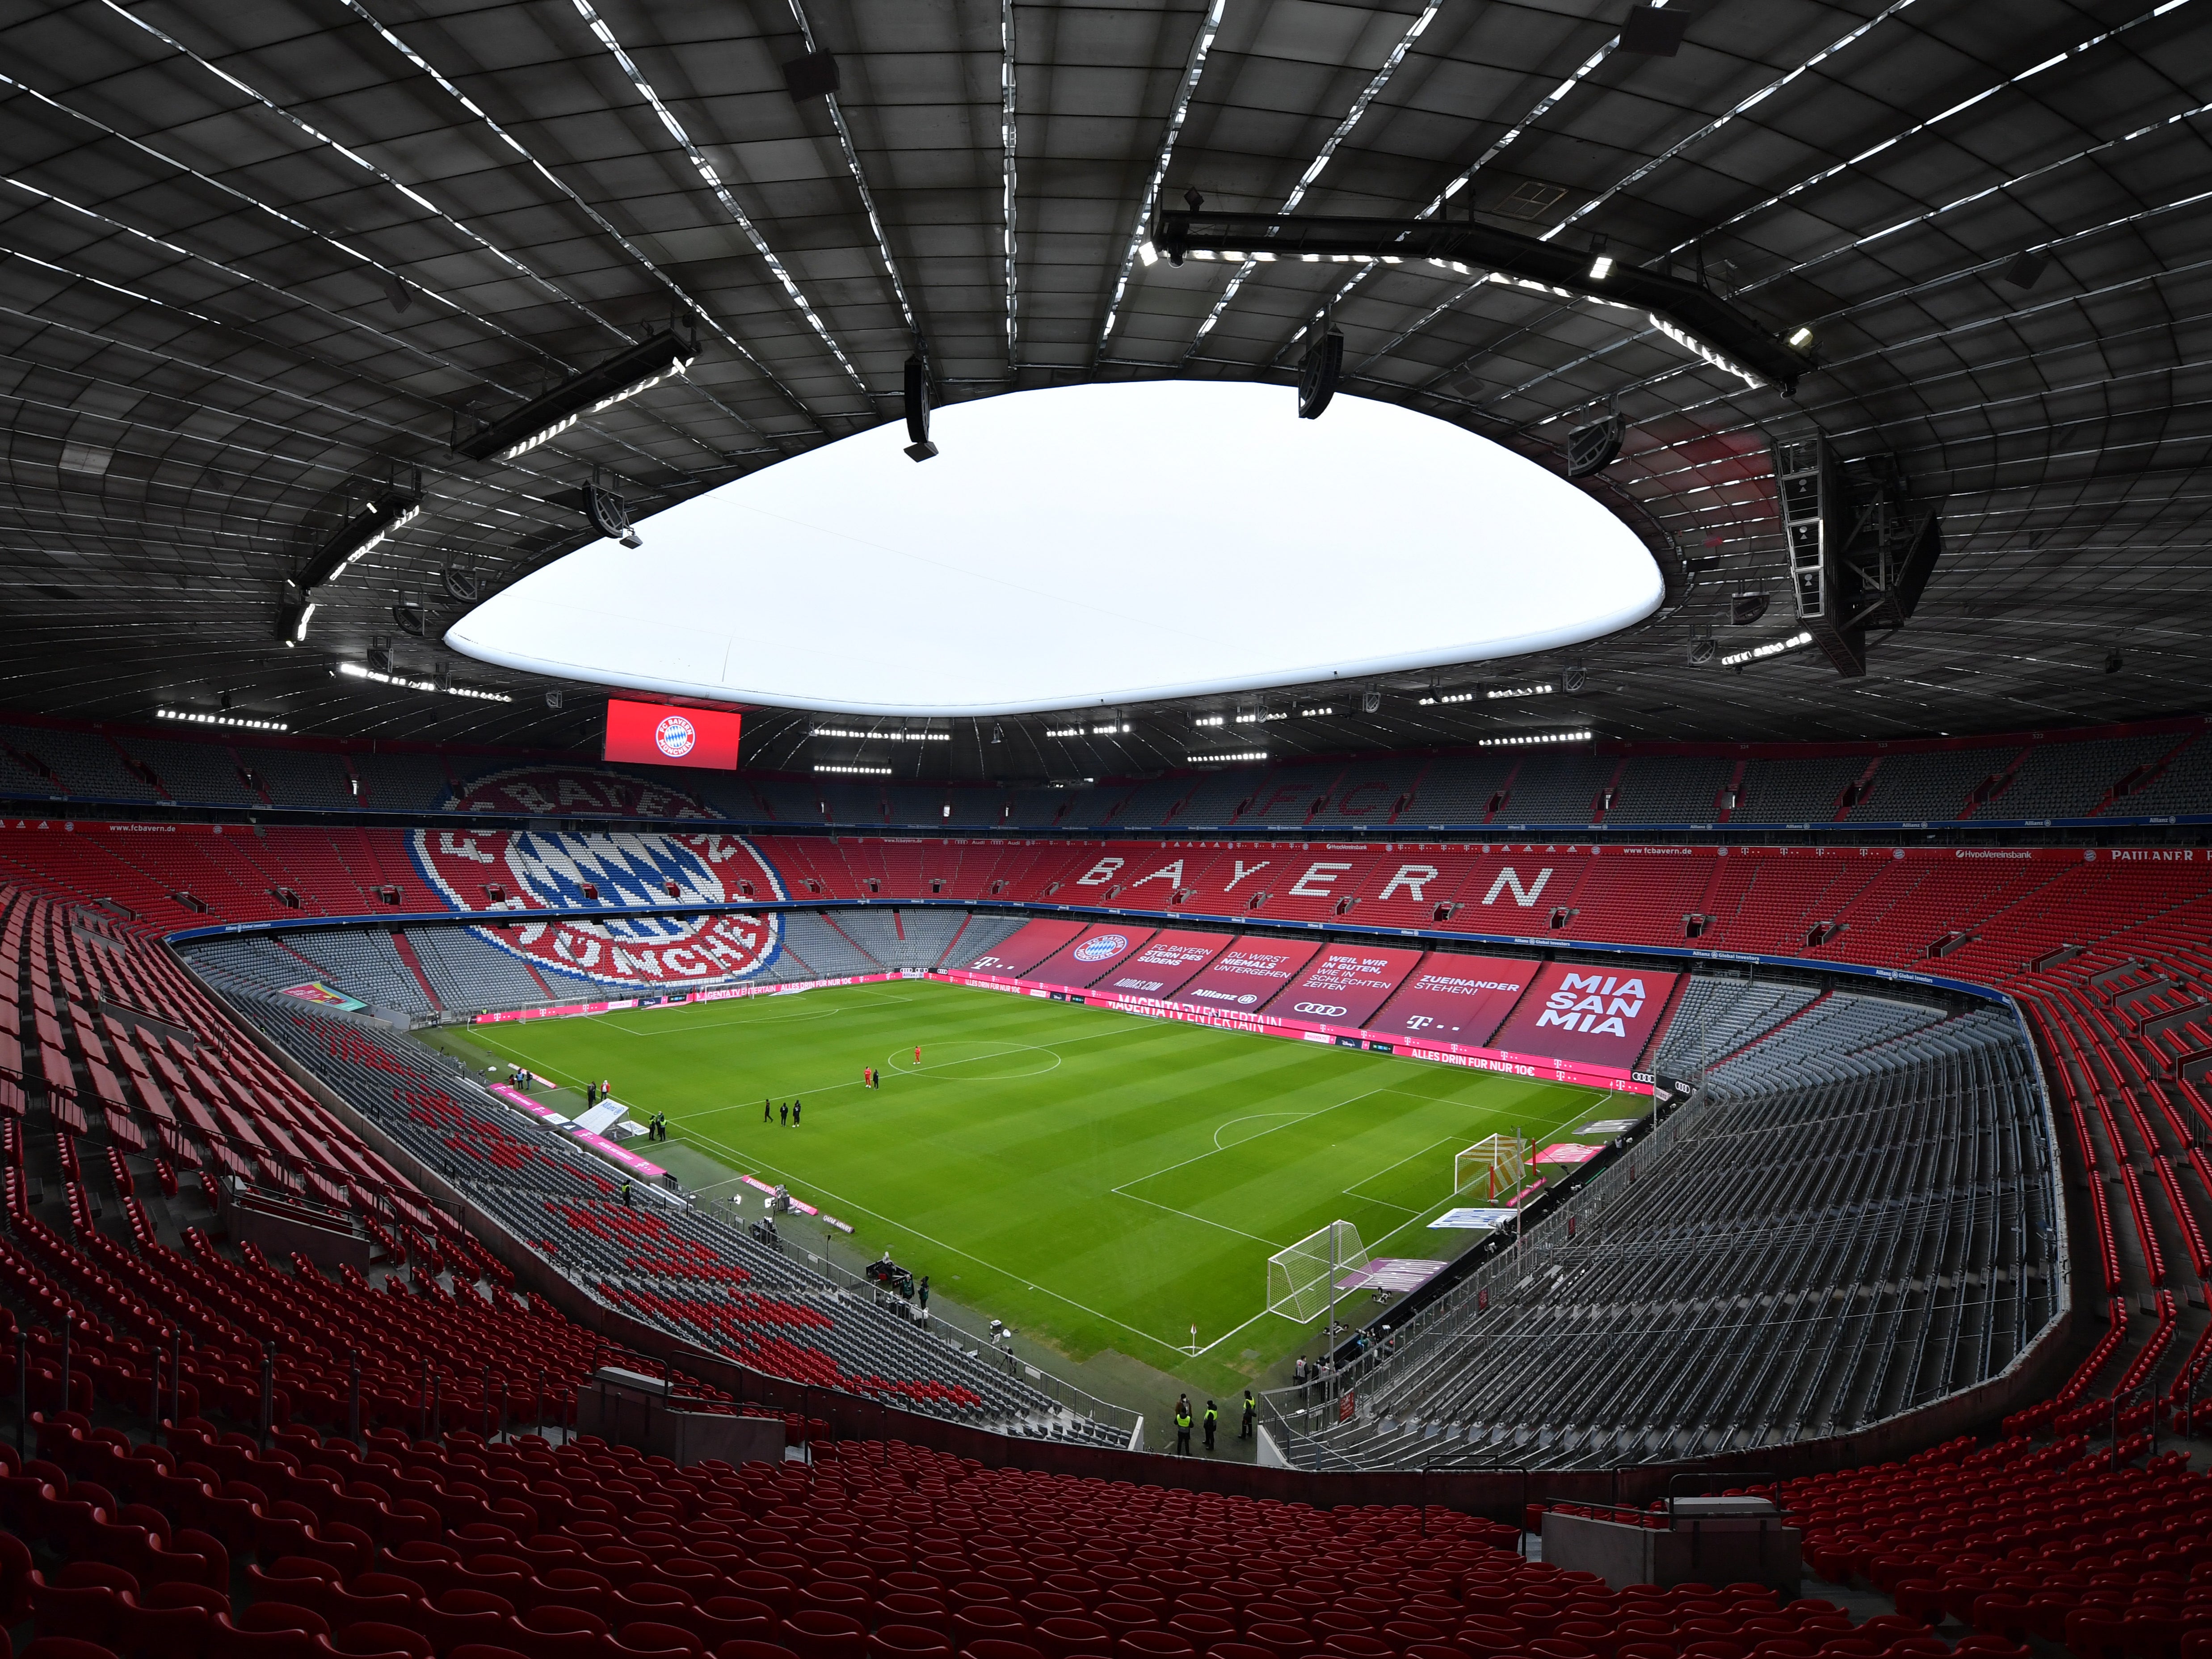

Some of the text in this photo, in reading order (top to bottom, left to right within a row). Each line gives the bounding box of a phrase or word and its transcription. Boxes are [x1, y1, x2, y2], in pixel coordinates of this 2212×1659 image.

[659, 718, 693, 735] FC BAYERN
[659, 739, 691, 754] MÜNCHEN
[1077, 857, 1553, 907] BAYERN
[1102, 935, 1124, 948] BAYERN
[1077, 948, 1114, 960] MÜNCHEN
[1144, 950, 1204, 961] STERN DES
[1168, 945, 1213, 956] BAYERN
[1137, 956, 1182, 966] SÜDENS
[1220, 958, 1277, 969] NIEMALS
[1249, 953, 1290, 963] WIRST
[1329, 955, 1388, 967] WEIL WIR
[1214, 964, 1291, 978] UNTERGEHEN
[1337, 964, 1381, 974] GUTEN,
[1113, 978, 1164, 991] ADIDAS.COM
[1309, 974, 1392, 989] SCHLECHTEN
[1420, 975, 1520, 992] ZUEINANDER
[1914, 974, 1933, 983] Investors
[732, 989, 740, 997] TV
[742, 985, 776, 996] ENTERTAIN
[781, 983, 799, 991] ALLES
[800, 981, 815, 990] DRIN
[978, 980, 990, 989] DRIN
[1000, 984, 1010, 992] NUR
[1302, 980, 1346, 991] ZEITEN
[1414, 982, 1478, 995] STEHEN!
[1559, 973, 1646, 999] MIA
[1190, 989, 1238, 1001] Allianz
[1119, 994, 1179, 1012] MAGENTA
[1203, 1006, 1282, 1027] ENTERTAIN
[1546, 992, 1644, 1018] SAN
[1535, 1009, 1626, 1037] MIA
[1411, 1048, 1440, 1061] ALLES
[1442, 1053, 1466, 1066] DRIN
[1489, 1060, 1513, 1073] NUR
[1514, 1064, 1535, 1076] 10€
[600, 1101, 618, 1112] Allianz
[751, 1179, 777, 1196] MAGENTA SPOR
[823, 1215, 852, 1232] QATAR AIRWAYS
